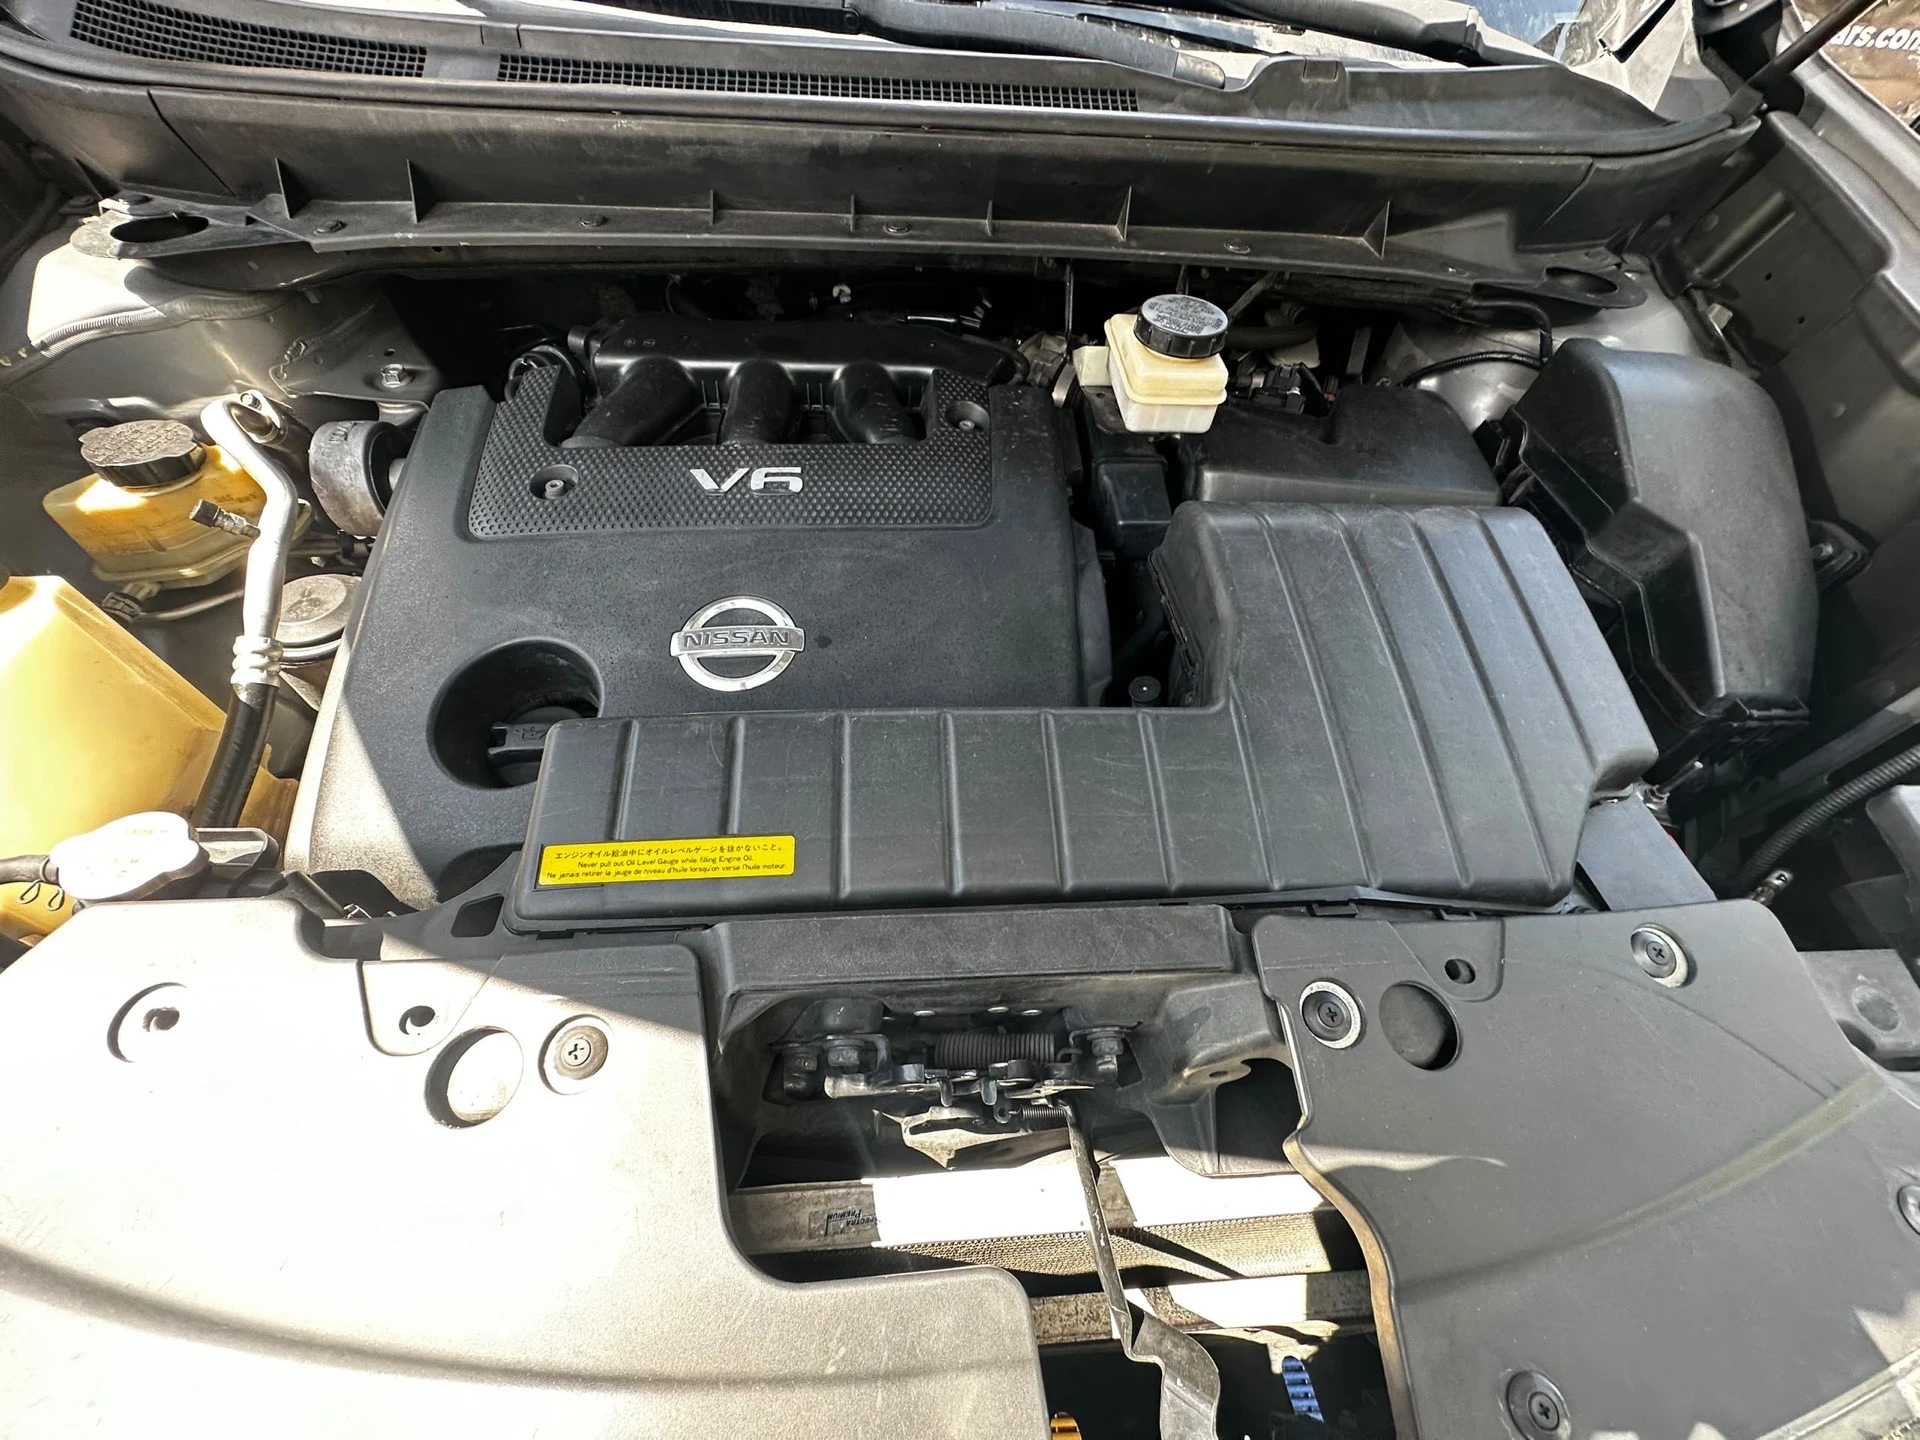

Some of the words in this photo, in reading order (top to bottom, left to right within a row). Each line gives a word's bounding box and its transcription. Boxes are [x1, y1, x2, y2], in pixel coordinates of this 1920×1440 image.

[1803, 21, 1920, 50] ars.com
[690, 466, 803, 496] V6
[683, 630, 792, 649] NISSAN
[600, 861, 611, 869] pull
[637, 858, 655, 866] Level
[658, 858, 679, 866] Gauge
[700, 856, 717, 864] filling
[719, 855, 741, 863] Engine
[558, 871, 580, 880] jamais
[613, 869, 632, 877] jauge
[667, 866, 688, 874] d'huile
[690, 865, 719, 874] lorsqu'on
[827, 1209, 862, 1220] PREMIUM
